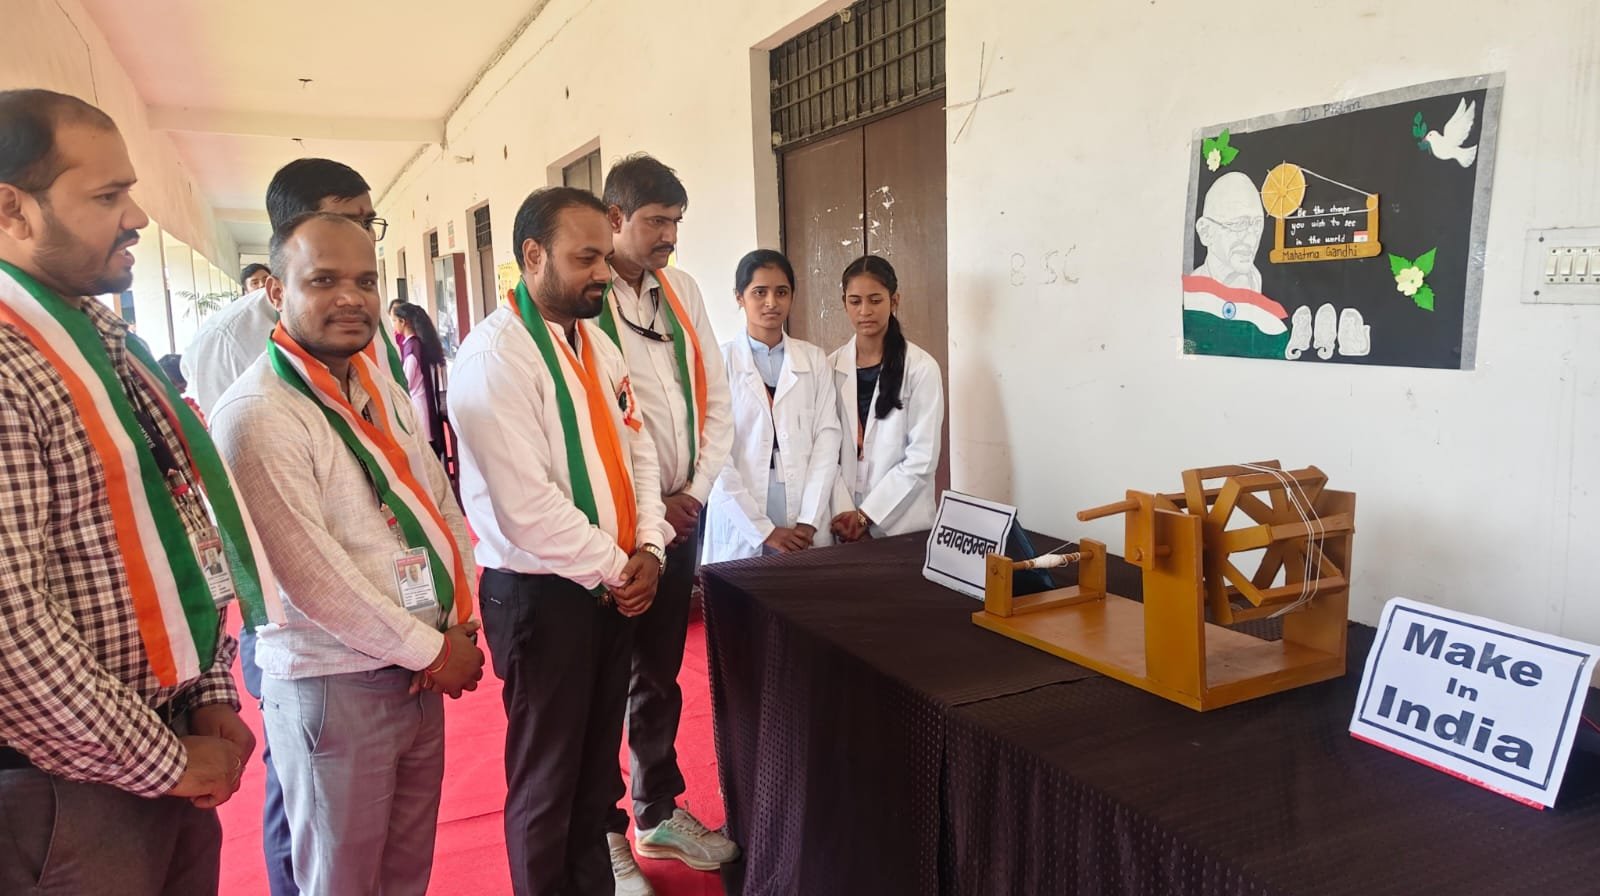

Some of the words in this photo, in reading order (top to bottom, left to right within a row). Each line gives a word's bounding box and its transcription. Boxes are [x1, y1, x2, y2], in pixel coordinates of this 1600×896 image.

[1297, 207, 1307, 217] Be
[1313, 204, 1325, 214] the
[1330, 204, 1350, 216] change
[1290, 222, 1305, 236] you
[1311, 218, 1326, 228] wish
[1330, 217, 1340, 227] to
[1344, 219, 1357, 227] see
[1295, 238, 1303, 246] in
[1308, 235, 1321, 244] the
[1325, 233, 1346, 243] world
[1282, 249, 1320, 261] Mahatma
[1325, 244, 1358, 257] Gandhi
[1402, 622, 1543, 687] Make
[1446, 677, 1479, 702] In
[1376, 684, 1534, 771] India
